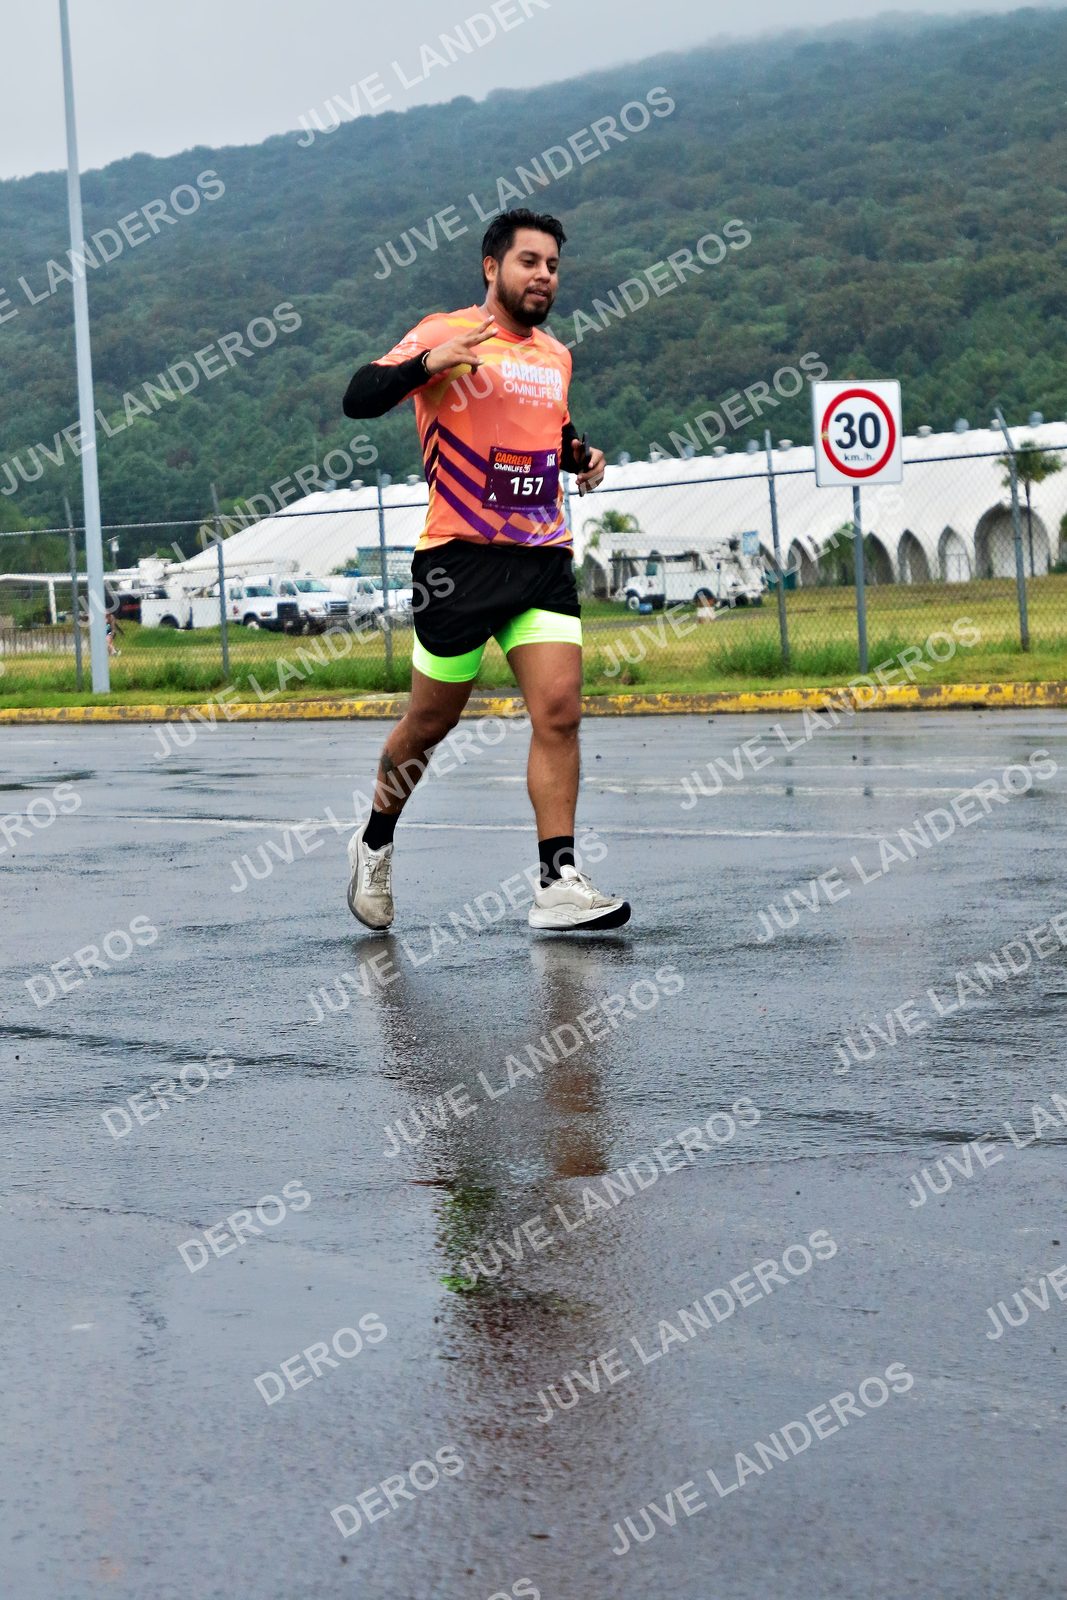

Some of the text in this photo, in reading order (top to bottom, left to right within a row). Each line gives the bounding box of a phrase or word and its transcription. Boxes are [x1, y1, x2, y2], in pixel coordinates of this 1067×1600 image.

[501, 360, 562, 386] CARRERA
[504, 381, 552, 399] OMNILIFE
[834, 412, 881, 449] 30
[495, 452, 532, 465] CARRERA
[510, 477, 544, 495] 157
